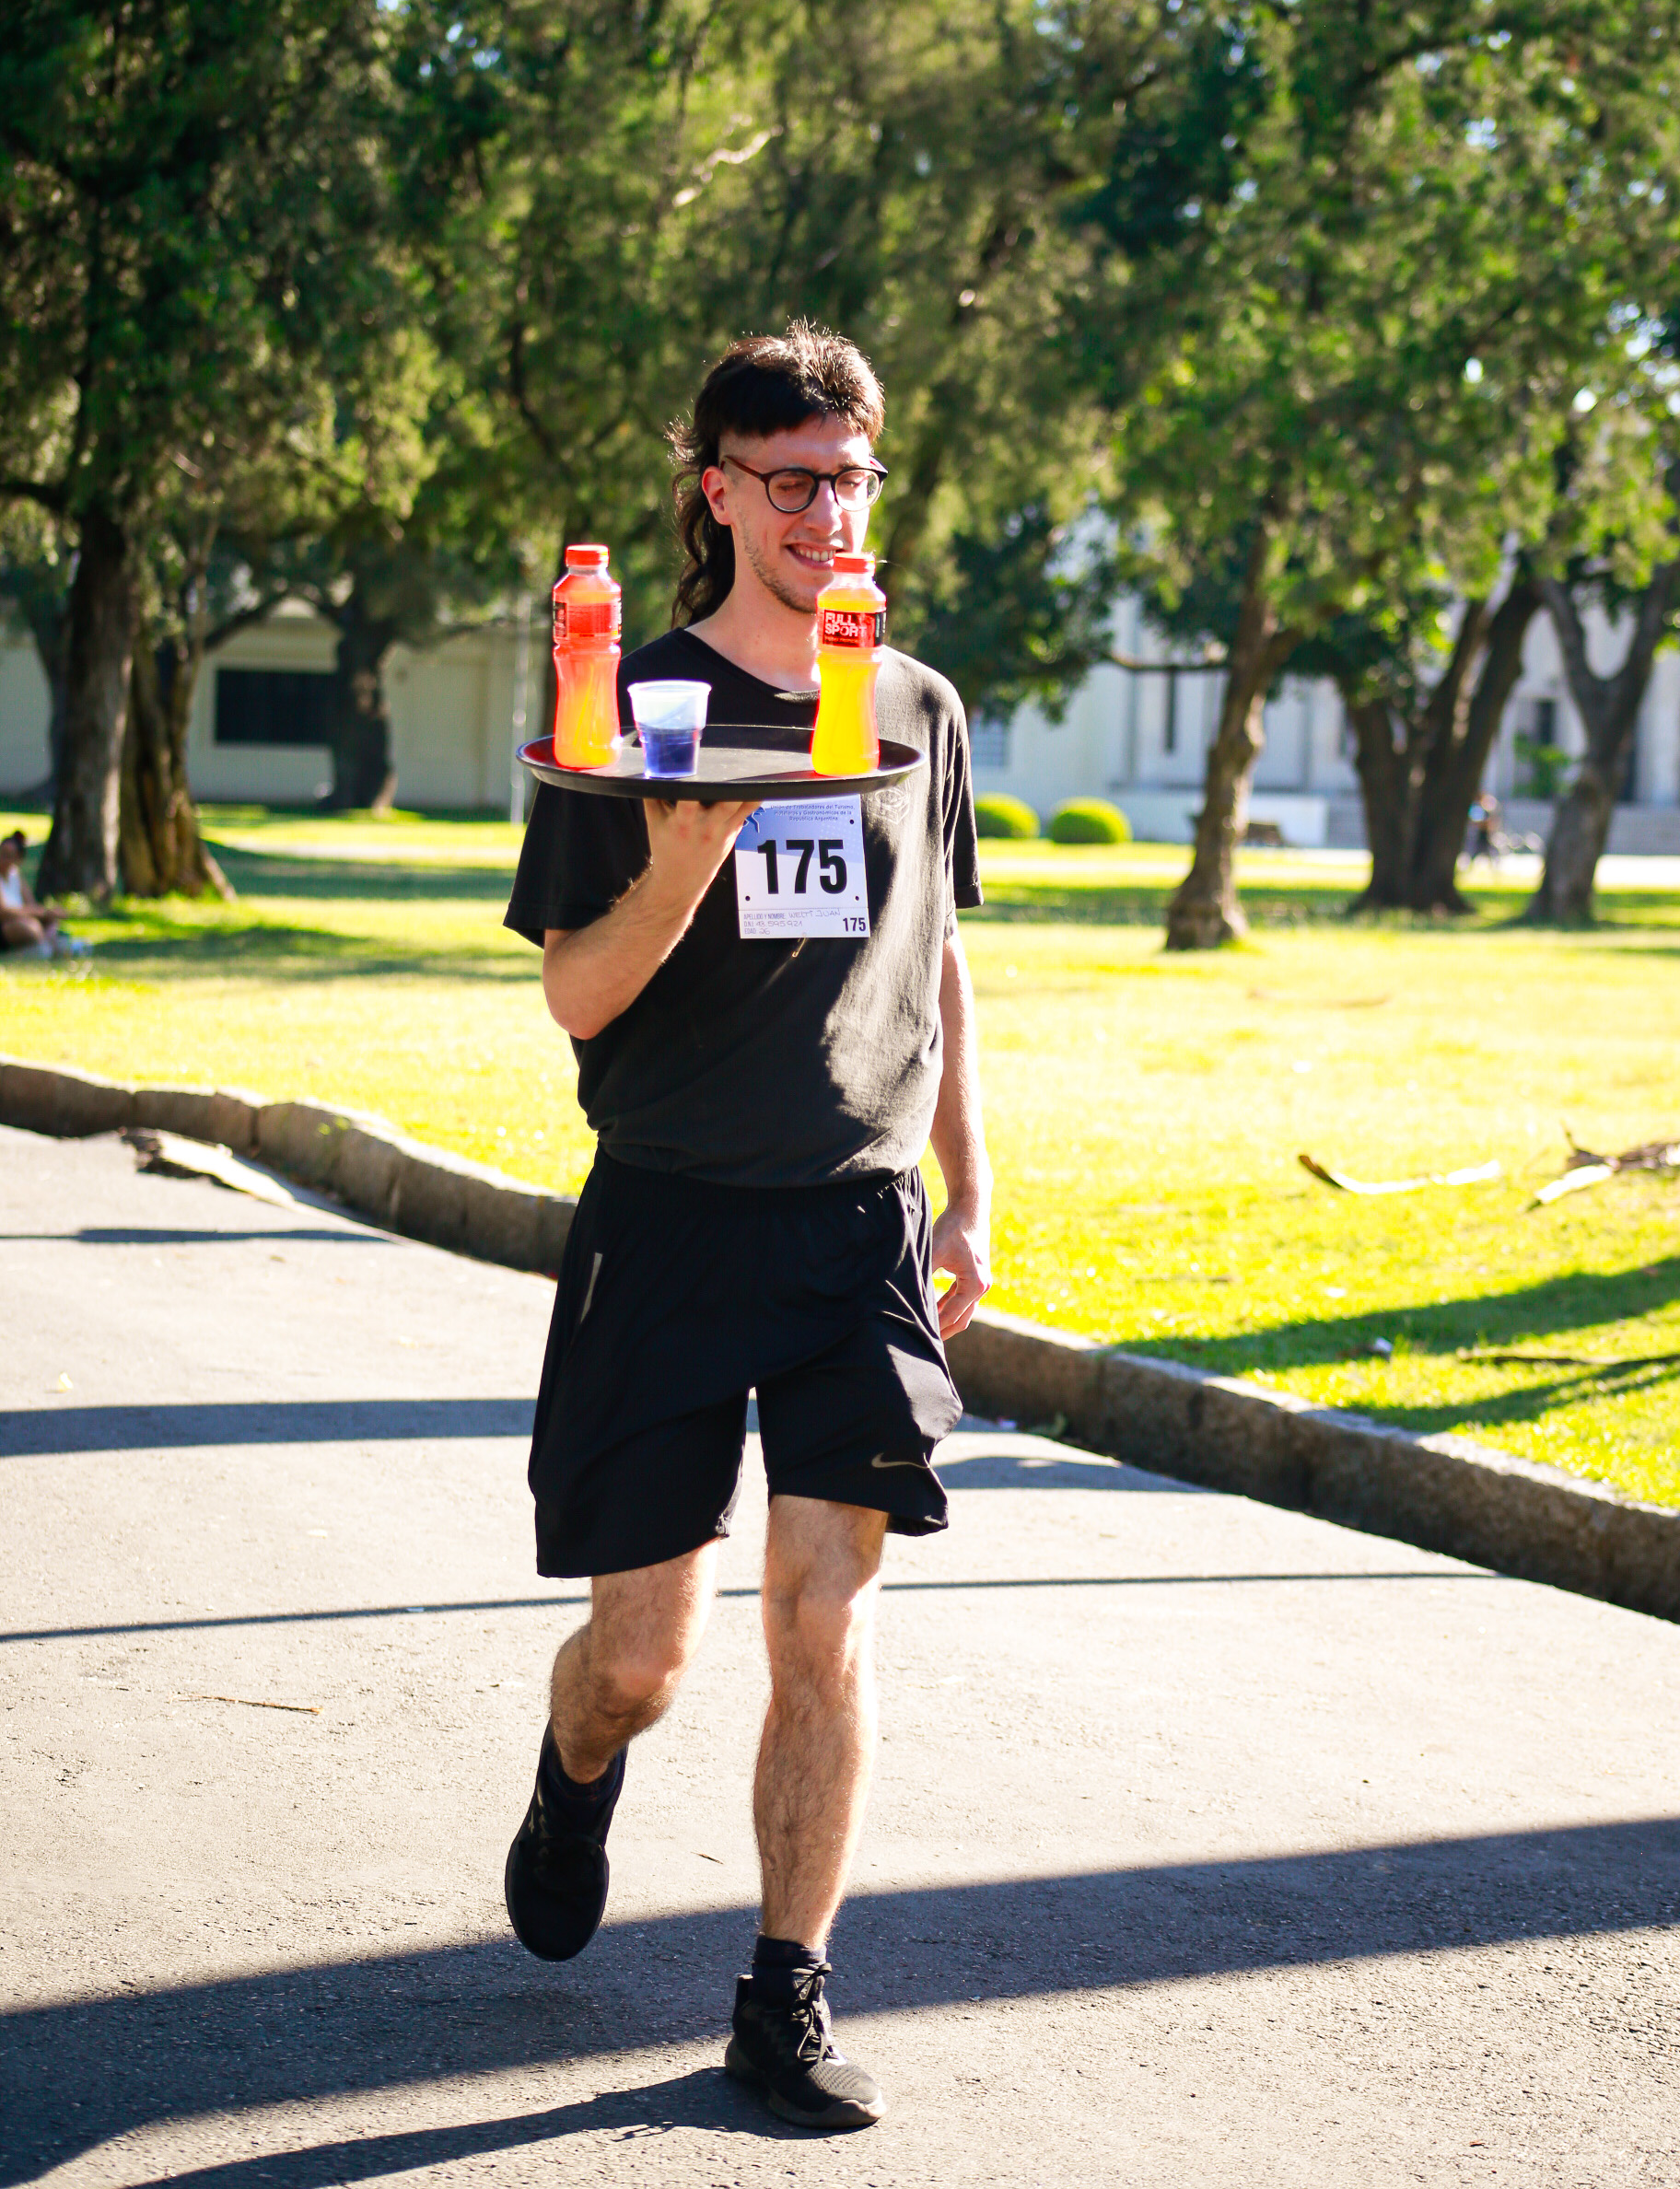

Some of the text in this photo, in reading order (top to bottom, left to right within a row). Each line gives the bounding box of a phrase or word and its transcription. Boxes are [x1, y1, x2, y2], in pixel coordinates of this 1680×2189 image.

[825, 612, 856, 626] FULL
[824, 623, 867, 637] SPORT
[757, 839, 847, 894] 175
[843, 917, 866, 932] 175
